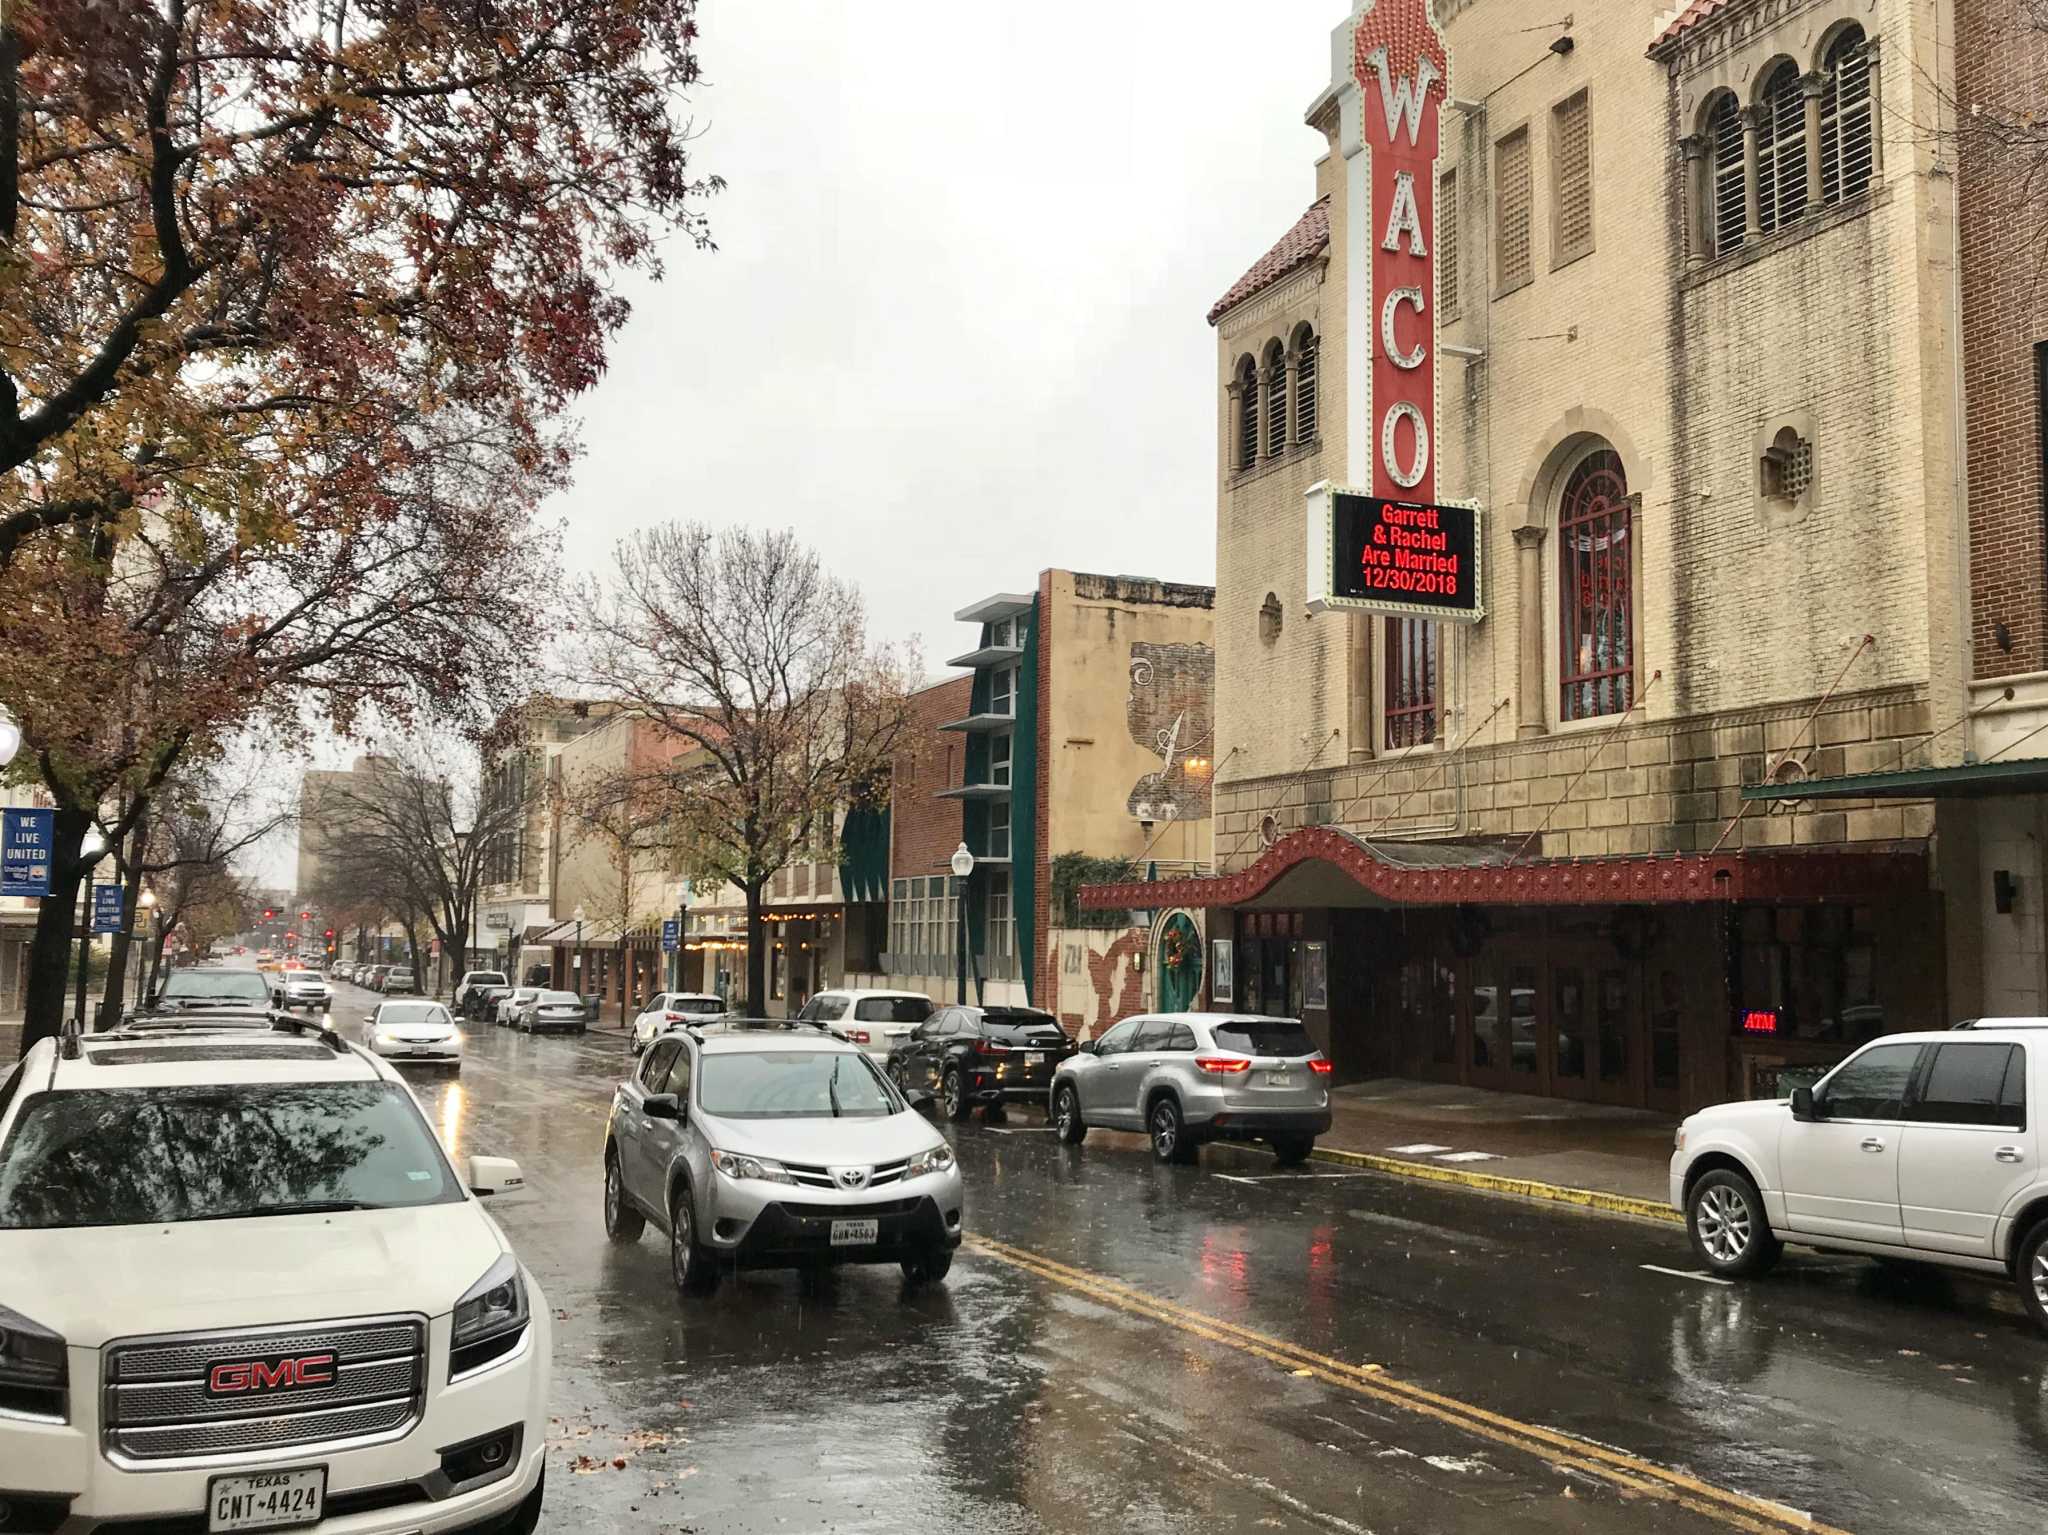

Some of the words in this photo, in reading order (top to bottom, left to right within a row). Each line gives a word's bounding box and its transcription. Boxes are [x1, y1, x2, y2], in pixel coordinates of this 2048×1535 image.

[1367, 42, 1442, 488] WACO
[1382, 503, 1439, 529] Garrett
[1373, 524, 1387, 545] &
[1390, 526, 1446, 551] Rachel
[1362, 545, 1390, 567] Are
[1395, 548, 1457, 574] Married
[1362, 567, 1457, 595] 12/30/2018
[20, 816, 37, 828] WE
[16, 832, 39, 844] LIVE
[7, 848, 46, 860] UNITED
[1744, 1012, 1776, 1030] ATM
[210, 1354, 334, 1392] GMC
[247, 1475, 290, 1489] TEXAS
